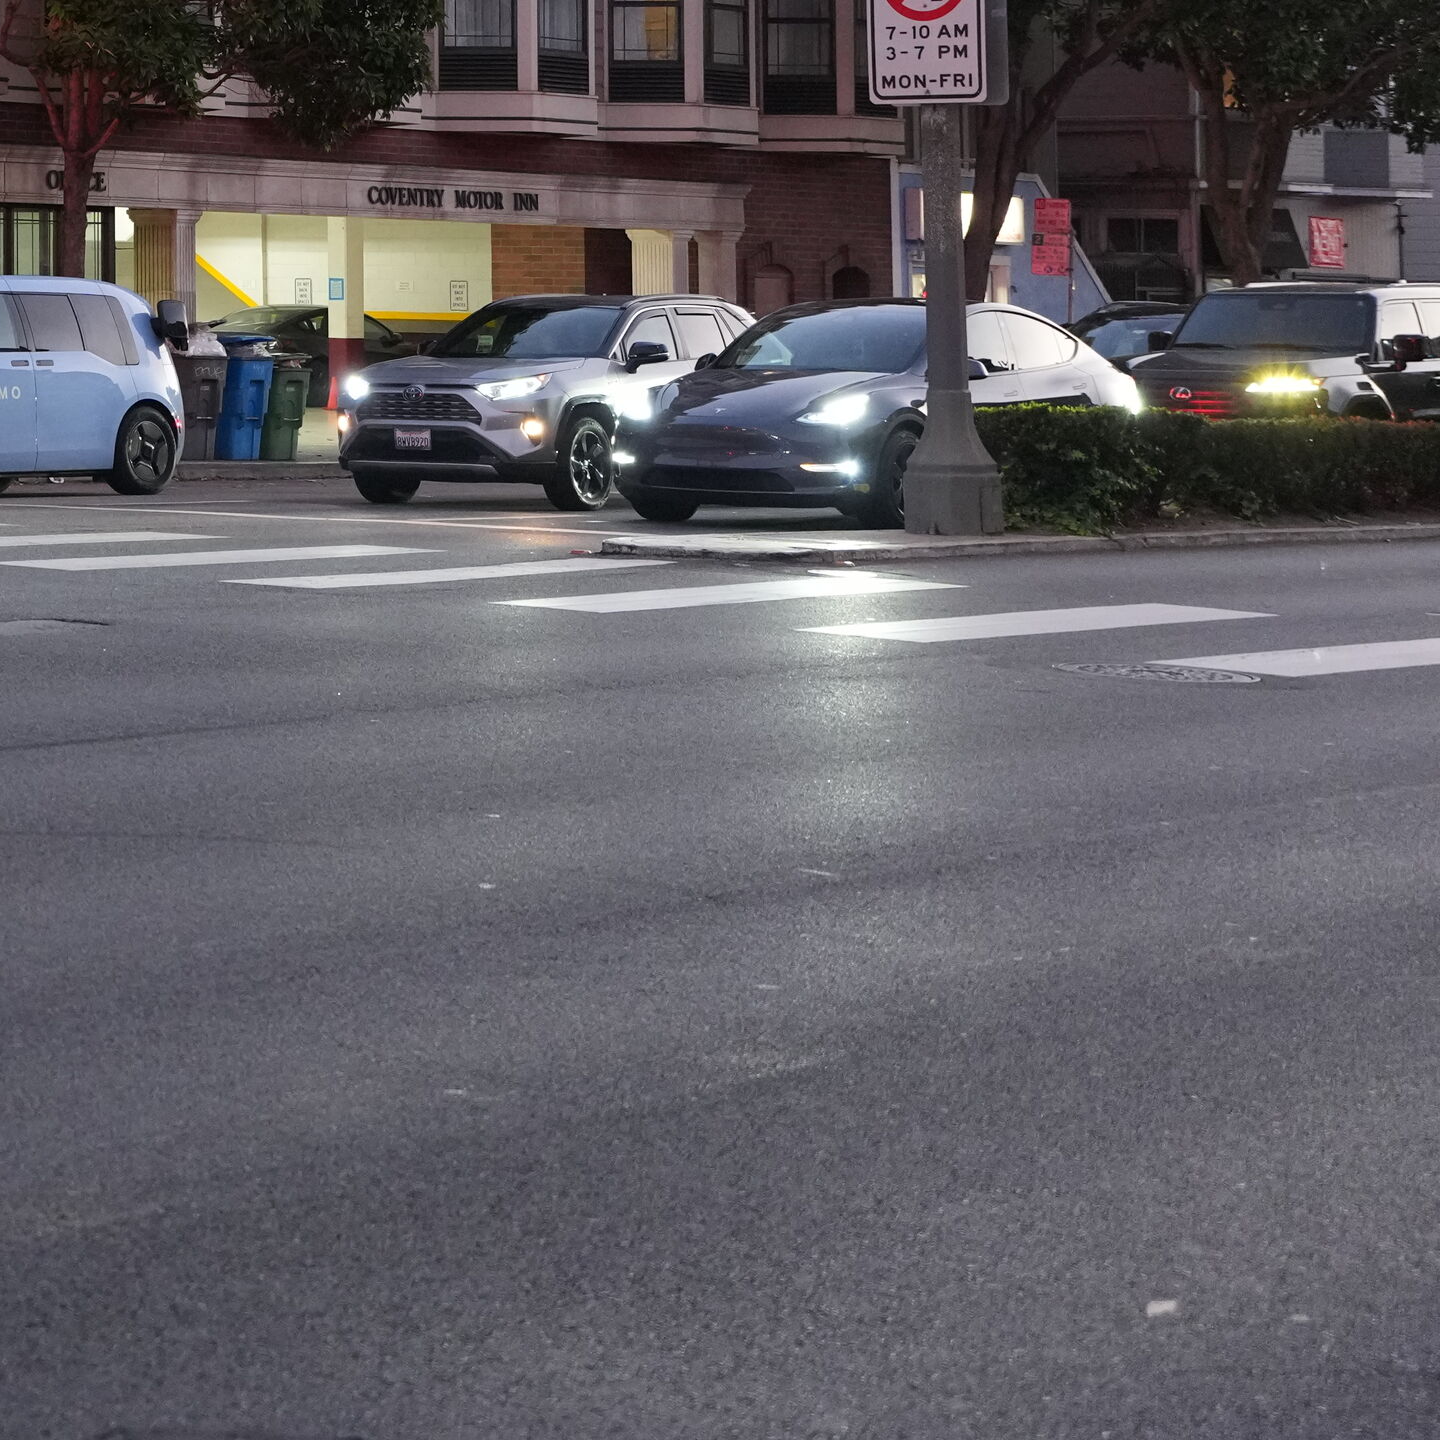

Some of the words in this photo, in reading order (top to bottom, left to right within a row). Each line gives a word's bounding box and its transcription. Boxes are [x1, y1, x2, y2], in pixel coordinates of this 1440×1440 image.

[937, 23, 969, 39] AM
[938, 44, 968, 59] PM
[882, 73, 973, 89] MON-FRI
[366, 185, 445, 208] COVENTRY
[454, 189, 504, 210] MOTOR
[512, 192, 540, 211] INN
